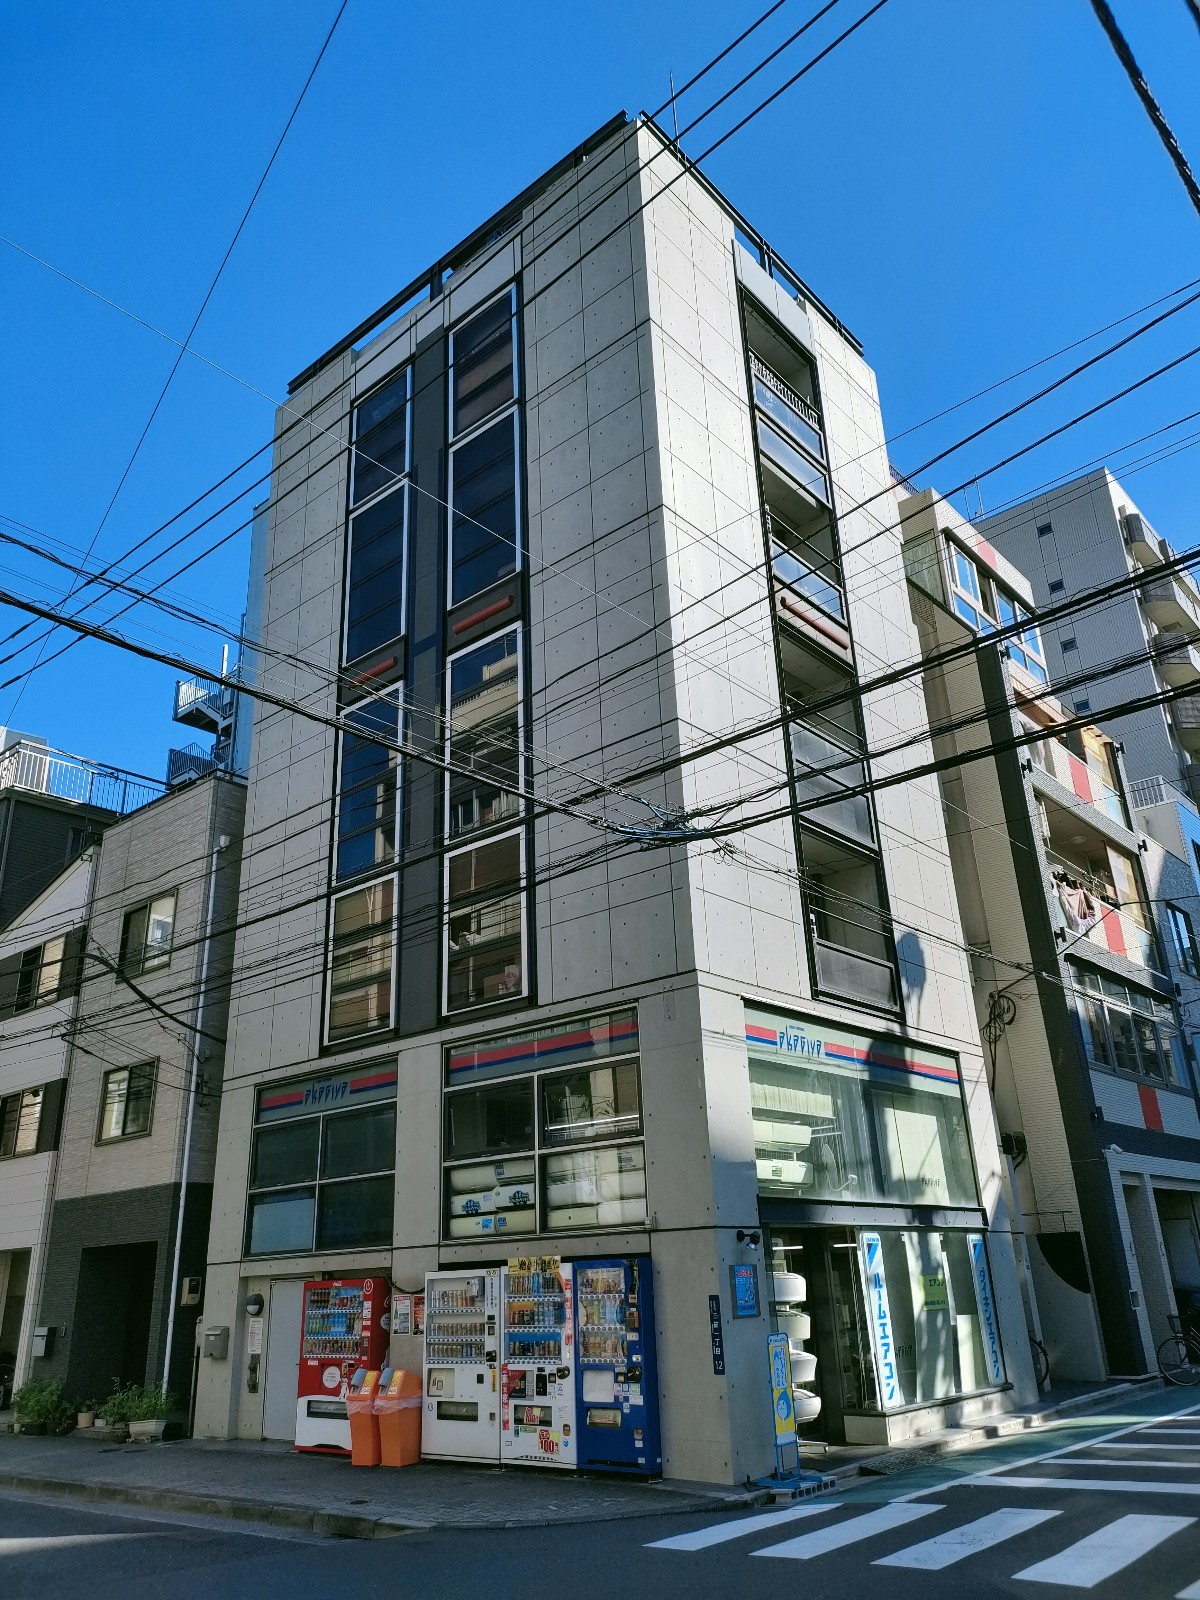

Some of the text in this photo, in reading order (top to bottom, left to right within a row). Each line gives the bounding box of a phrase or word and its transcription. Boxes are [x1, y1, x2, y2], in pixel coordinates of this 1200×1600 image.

[873, 1272, 895, 1400] ルームエアコン
[978, 1266, 1000, 1379] ダイキンエアコン
[715, 1360, 723, 1370] 12
[539, 1440, 554, 1453] 100
